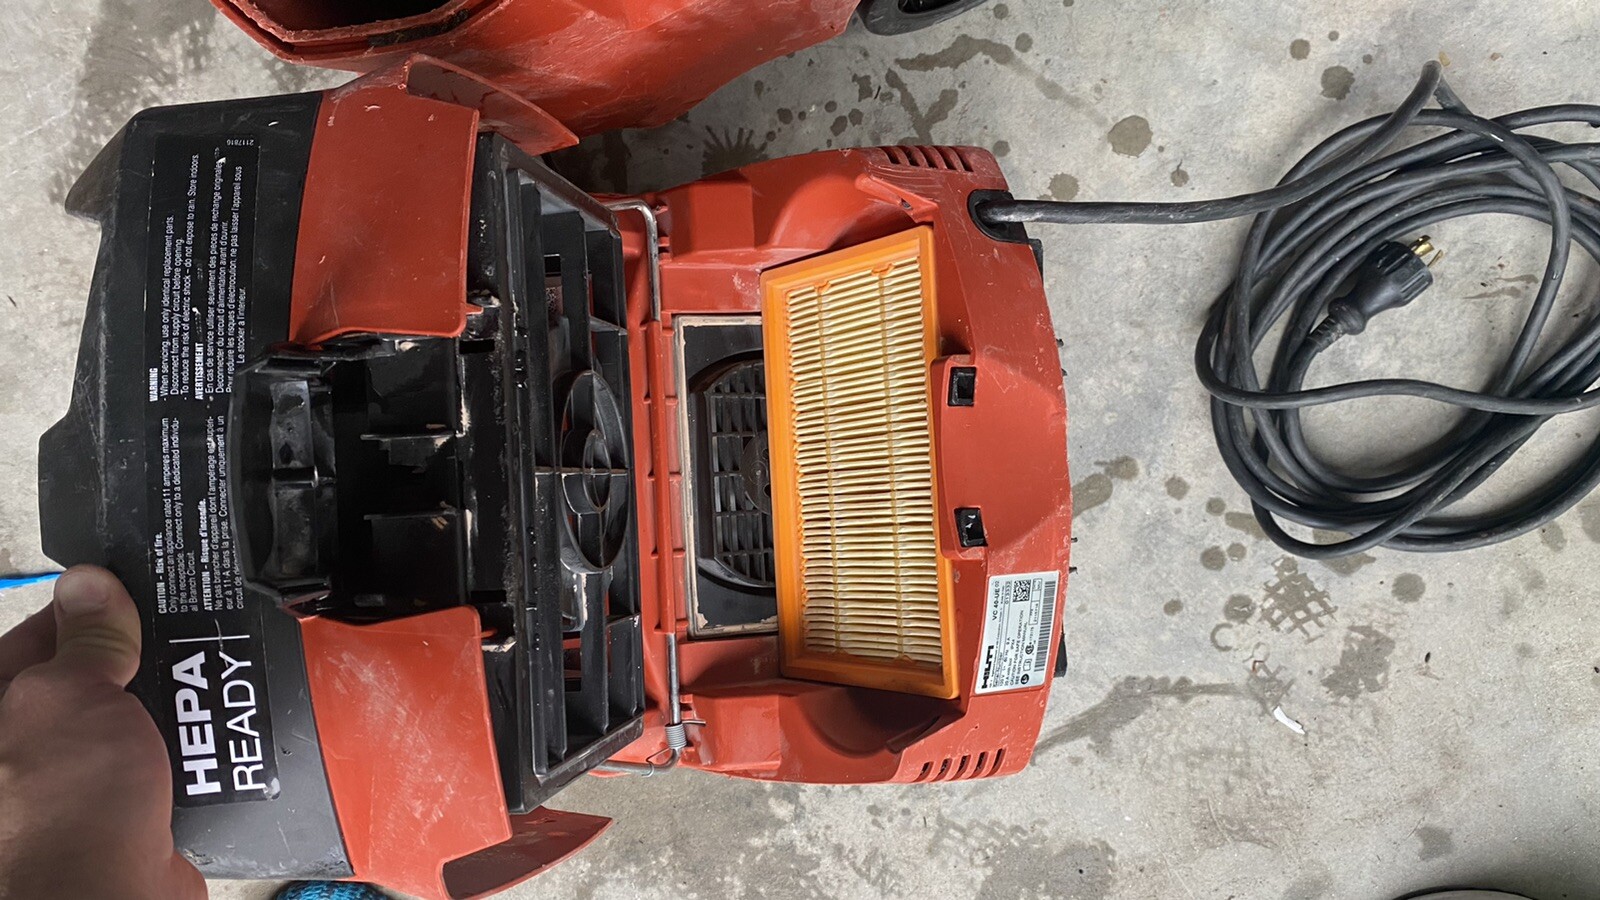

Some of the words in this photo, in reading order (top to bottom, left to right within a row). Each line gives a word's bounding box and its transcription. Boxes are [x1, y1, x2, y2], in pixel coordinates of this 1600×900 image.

[189, 154, 198, 178] indoors.
[187, 180, 196, 196] Store
[232, 183, 241, 210] l'appareil
[188, 198, 196, 212] rain.
[211, 192, 221, 221] rechange
[165, 216, 173, 234] parts.
[210, 223, 218, 231] de
[231, 212, 239, 233] laisser
[218, 221, 228, 246] d'ouvrir.
[230, 235, 239, 246] pas
[164, 235, 173, 276] replacement
[175, 238, 184, 266] opening.
[184, 258, 192, 267] do
[208, 256, 216, 268] des
[217, 247, 226, 265] avant
[230, 249, 237, 257] ne
[173, 268, 181, 289] before
[183, 275, 191, 295] shock
[207, 270, 215, 305] seulement
[161, 278, 170, 307] identical
[171, 291, 180, 311] circuit
[217, 267, 226, 314] d'alimentation
[161, 309, 170, 323] only
[182, 297, 190, 322] electric
[172, 314, 181, 336] supply
[216, 315, 225, 336] circuit
[227, 311, 237, 336] risques
[171, 338, 179, 353] from
[206, 331, 214, 356] service
[216, 338, 224, 347] du
[226, 338, 234, 348] les
[237, 327, 245, 352] stocker
[181, 346, 189, 358] the
[206, 358, 214, 367] de
[237, 354, 244, 363] Le
[170, 355, 179, 395] Disconnect
[195, 343, 203, 399] AVERTISSEMENT
[149, 368, 158, 401] WARNING
[160, 375, 168, 396] When
[181, 386, 189, 394] To
[205, 384, 214, 393] En
[217, 416, 224, 425] un
[171, 418, 179, 447] individu-
[217, 435, 226, 476] uniquement
[163, 455, 171, 486] amperes
[172, 450, 180, 484] dedicated
[207, 455, 217, 495] l'ampérage
[163, 499, 171, 517] rated
[218, 479, 227, 517] Connecter
[174, 502, 183, 517] only
[198, 499, 206, 537] d'incendie.
[154, 532, 162, 547] fire.
[164, 519, 174, 554] appliance
[175, 519, 184, 549] Connect
[209, 515, 219, 549] d'appareil
[220, 520, 230, 539] prise.
[167, 555, 174, 564] an
[201, 539, 209, 562] Risque
[222, 551, 230, 568] dans
[155, 558, 164, 573] Risk
[177, 551, 187, 590] receptacle.
[187, 551, 195, 576] Circuit.
[212, 551, 221, 583] brancher
[167, 566, 176, 594] connect
[189, 578, 197, 603] Branch
[234, 577, 242, 586] de
[156, 582, 167, 614] CAUTION
[202, 572, 213, 610] ATTENTION
[215, 585, 223, 598] pas
[235, 588, 244, 609] circuit
[169, 596, 178, 613] Only
[215, 600, 223, 609] Ne
[992, 611, 998, 620] VC
[981, 645, 994, 689] HILTI
[172, 651, 221, 796] HEPA
[218, 651, 267, 791] READY
